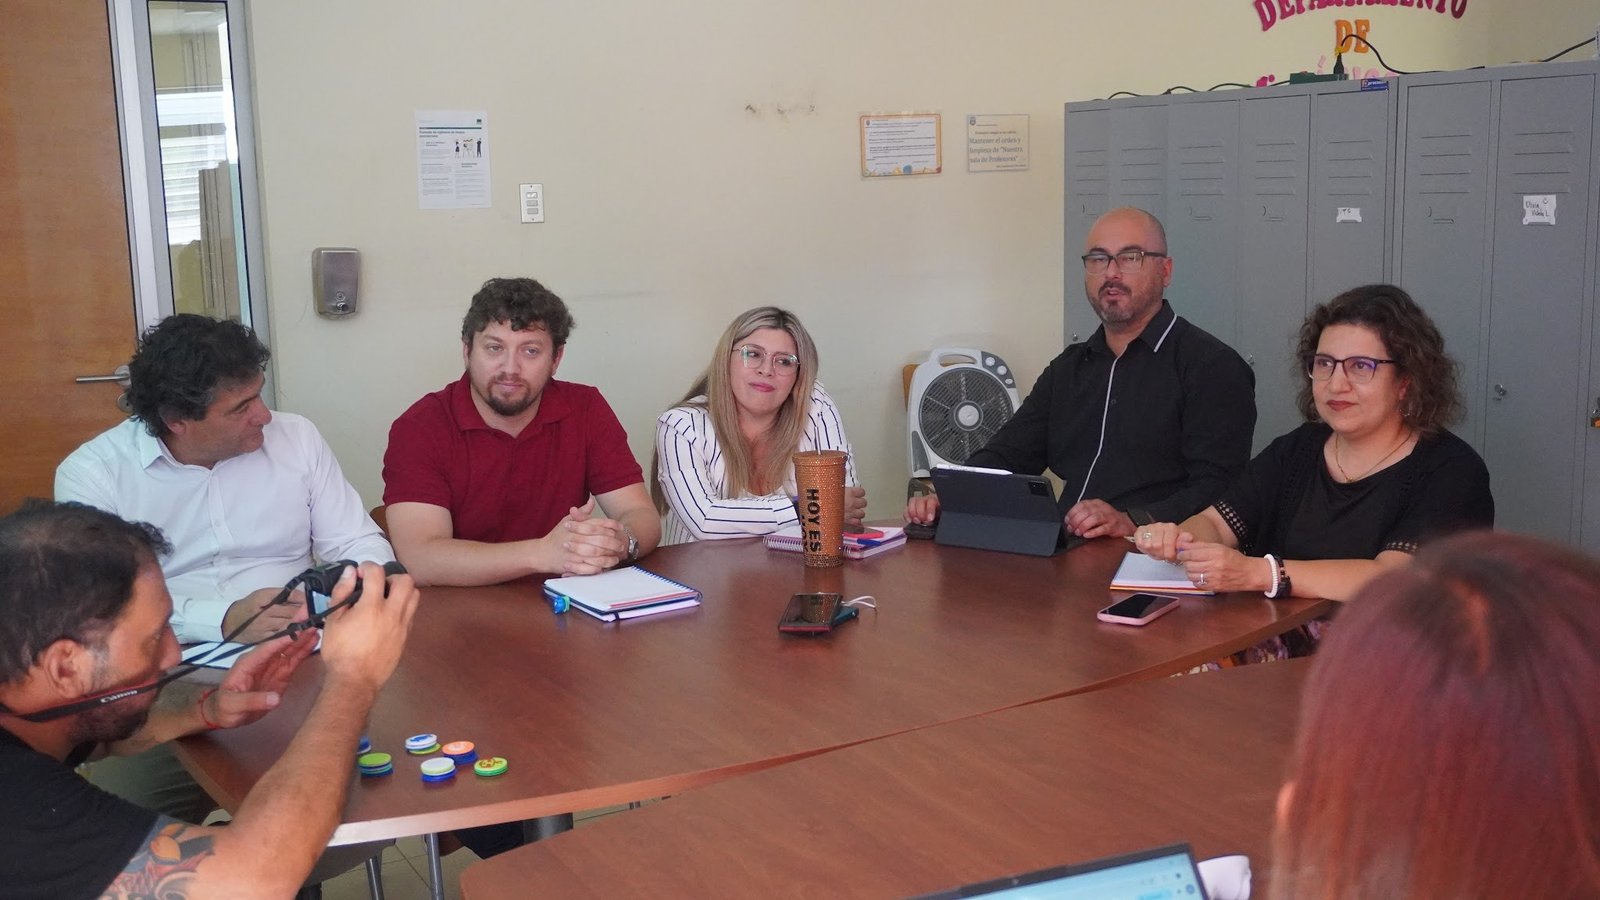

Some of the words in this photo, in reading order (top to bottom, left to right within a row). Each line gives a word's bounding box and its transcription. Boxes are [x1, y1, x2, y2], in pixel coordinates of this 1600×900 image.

[1335, 19, 1370, 53] DE
[806, 488, 821, 525] HOY
[809, 530, 822, 553] ES
